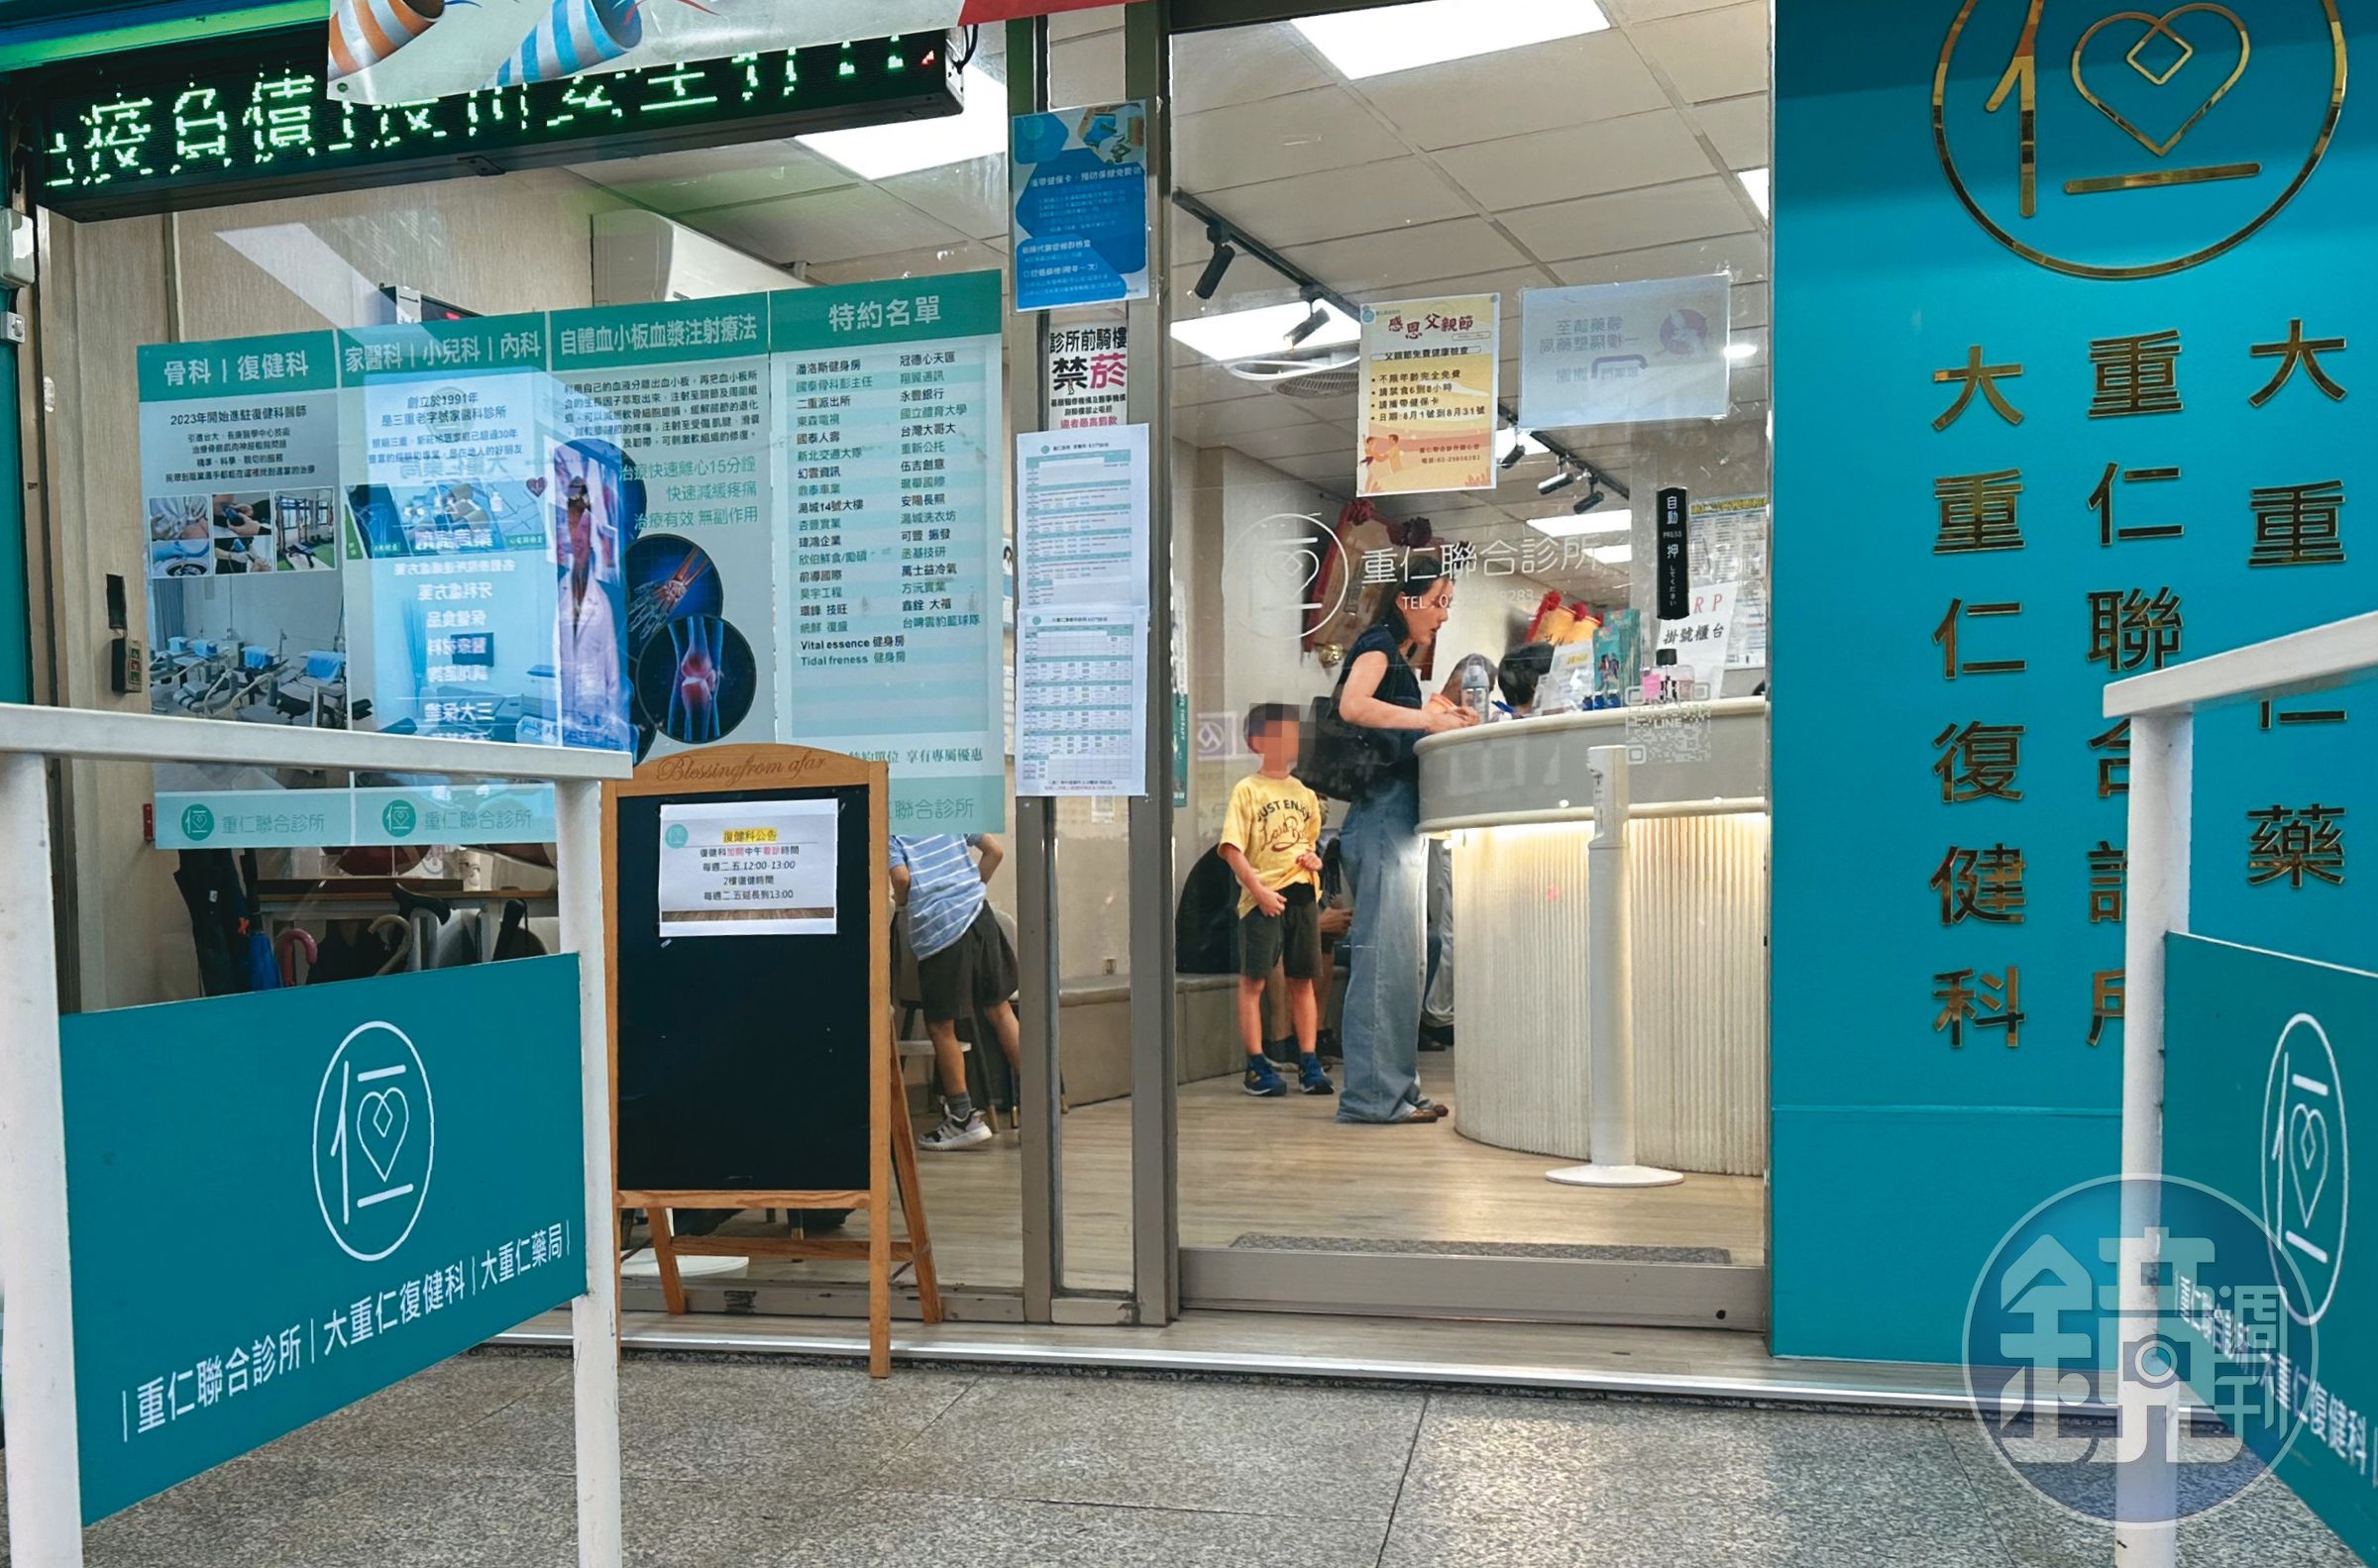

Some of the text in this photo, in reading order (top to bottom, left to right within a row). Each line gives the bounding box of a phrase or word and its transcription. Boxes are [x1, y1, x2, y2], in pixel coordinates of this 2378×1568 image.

[828, 294, 941, 333] 特約名單
[1388, 312, 1473, 340] 感恩父親節
[561, 313, 757, 357] 自體血小板血漿注射療法
[1049, 326, 1128, 354] 診所前騎樓
[345, 330, 542, 372] 家醫科 小兒科 內科
[163, 351, 309, 386] 骨科 復健科
[1051, 352, 1128, 395] 禁菸
[901, 422, 957, 438] 台灣大哥大
[667, 479, 757, 502] 快速減緩疼痛
[634, 505, 758, 531] 治療有效 無副作用
[1361, 535, 1597, 583] 重仁聯合診所
[801, 640, 824, 651] Vital
[826, 638, 870, 650] essence
[1663, 623, 1724, 645] 掛號櫃台
[802, 655, 826, 667] Tidal
[828, 654, 869, 666] freness
[1930, 344, 2026, 1047] 大重仁復健科
[1654, 717, 1682, 729] LINE
[788, 750, 826, 778] afar
[424, 808, 533, 831] 重仁聯合診所
[894, 798, 975, 820] 聯合診所
[222, 813, 326, 834] 重仁聯合診所
[137, 1222, 563, 1435] 重仁聯合診所 大重仁復健科 大重仁藥局
